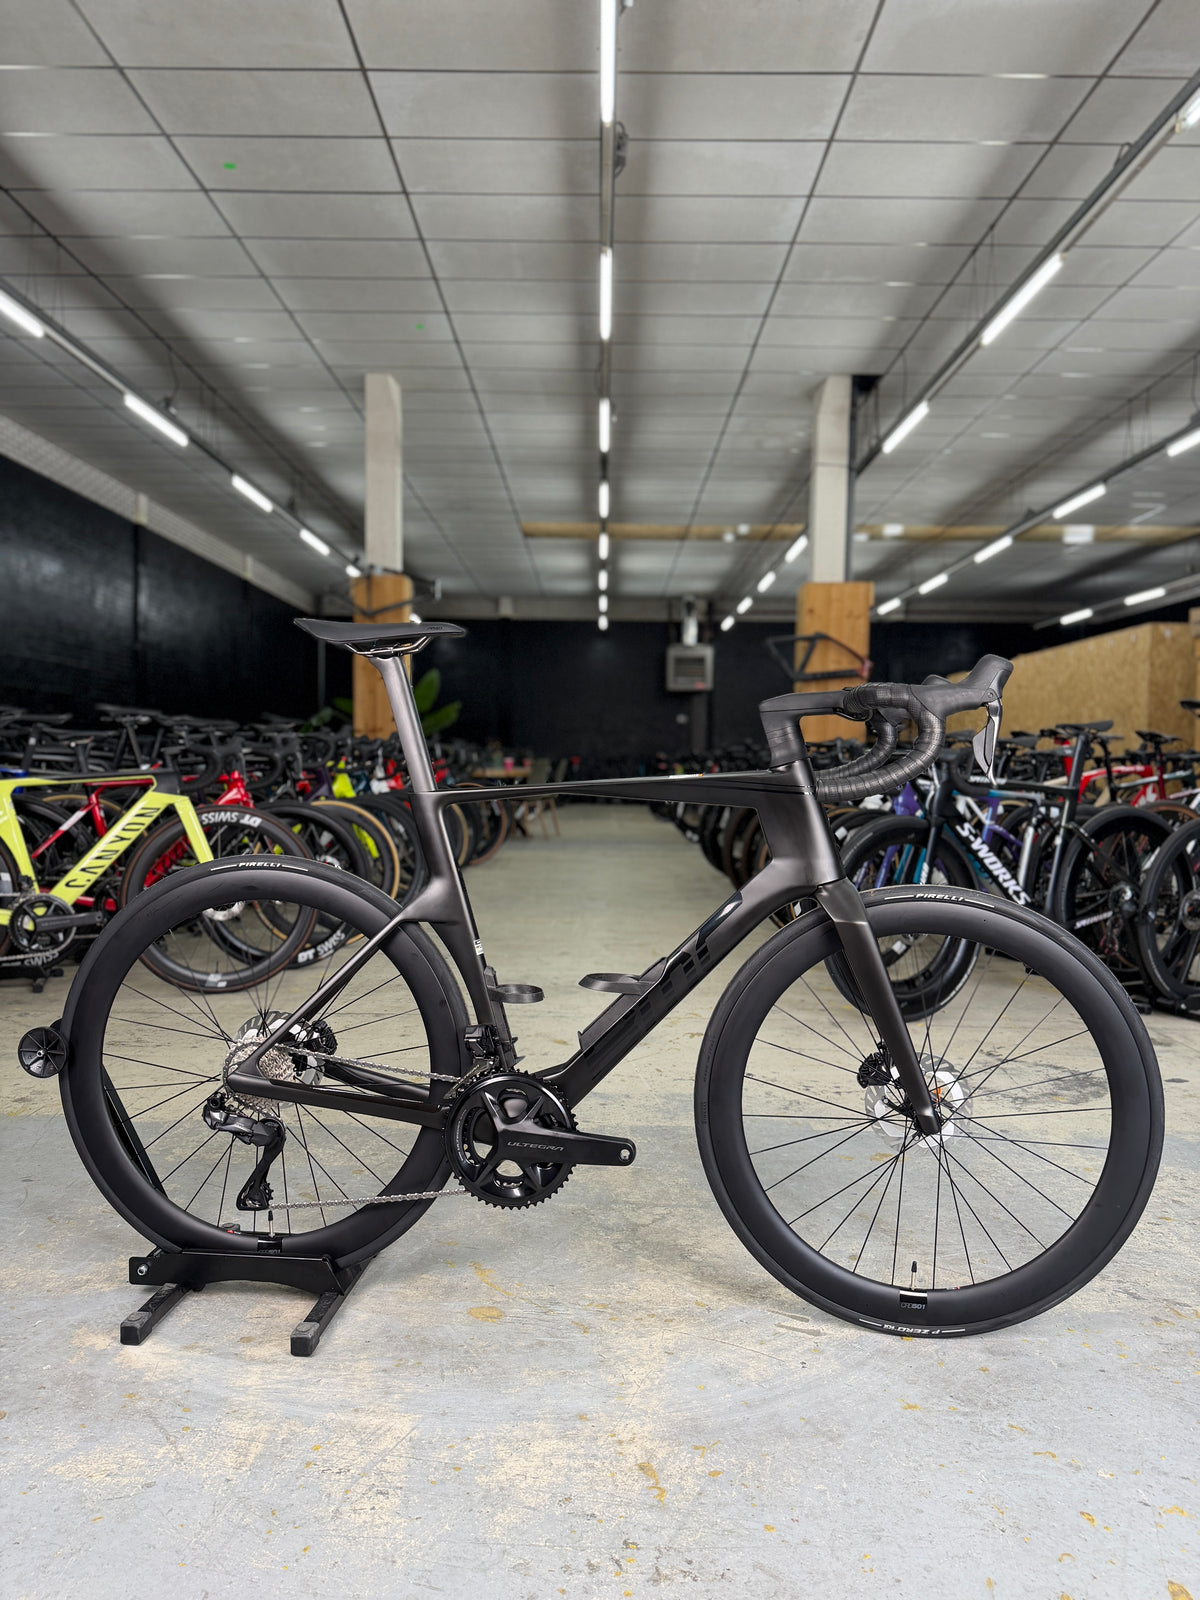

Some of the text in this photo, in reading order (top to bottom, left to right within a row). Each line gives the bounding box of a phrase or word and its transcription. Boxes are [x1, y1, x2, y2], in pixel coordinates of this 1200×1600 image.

[201, 811, 262, 828] DT SWISS
[64, 807, 162, 889] CANYON
[955, 822, 1031, 905] S-WORKS
[915, 893, 964, 902] PIRELLI
[297, 948, 316, 963] DT
[507, 1141, 564, 1152] ULTEGRA
[897, 1326, 930, 1334] ZERO
